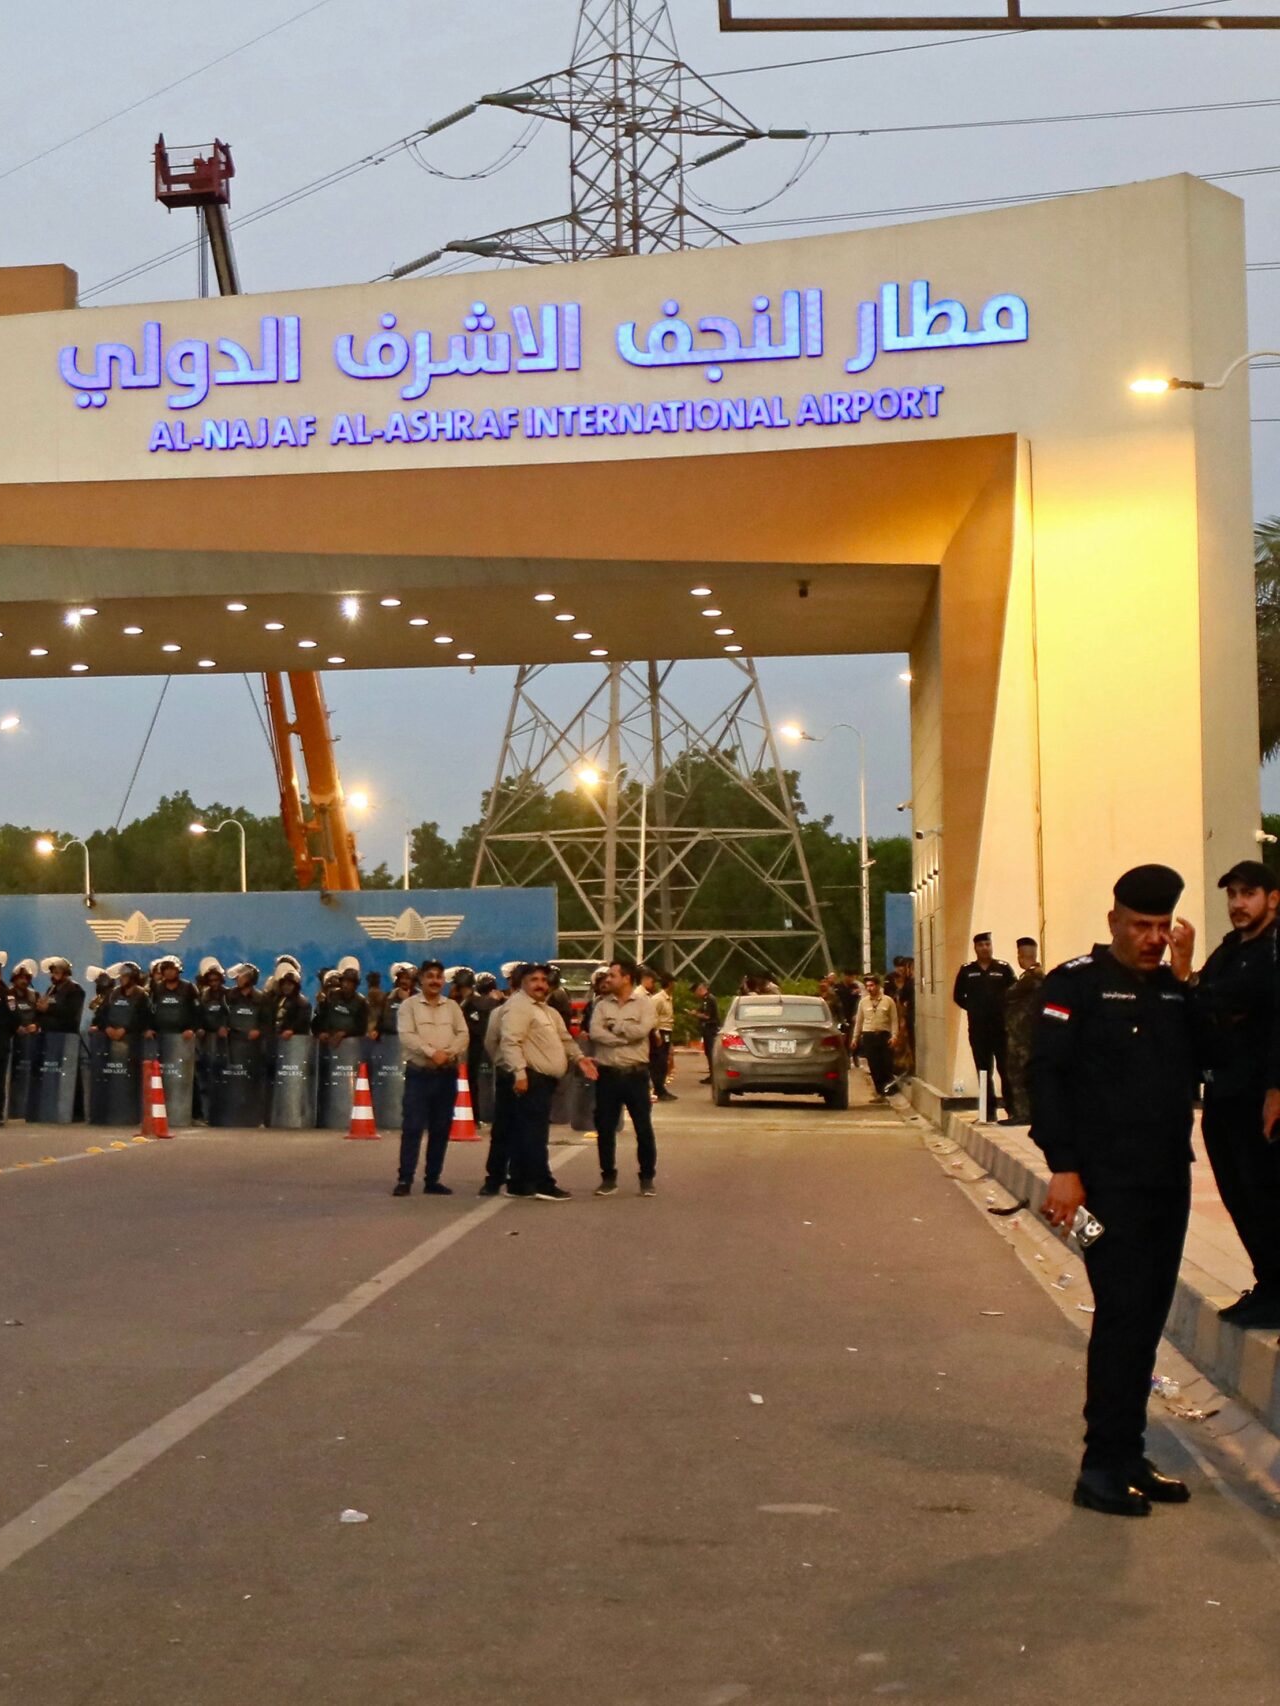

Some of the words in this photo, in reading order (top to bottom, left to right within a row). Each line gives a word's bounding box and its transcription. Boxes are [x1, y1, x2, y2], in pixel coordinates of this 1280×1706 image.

[57, 315, 303, 411] الدولي
[334, 301, 582, 401] الاشرف
[615, 288, 825, 384] النجف
[844, 279, 1030, 375] مطار
[148, 415, 318, 453] AL-NAJAF
[329, 406, 520, 446] AL-ASHRAF
[523, 396, 791, 439] INTERNATIONAL
[795, 384, 946, 427] AIRPORT
